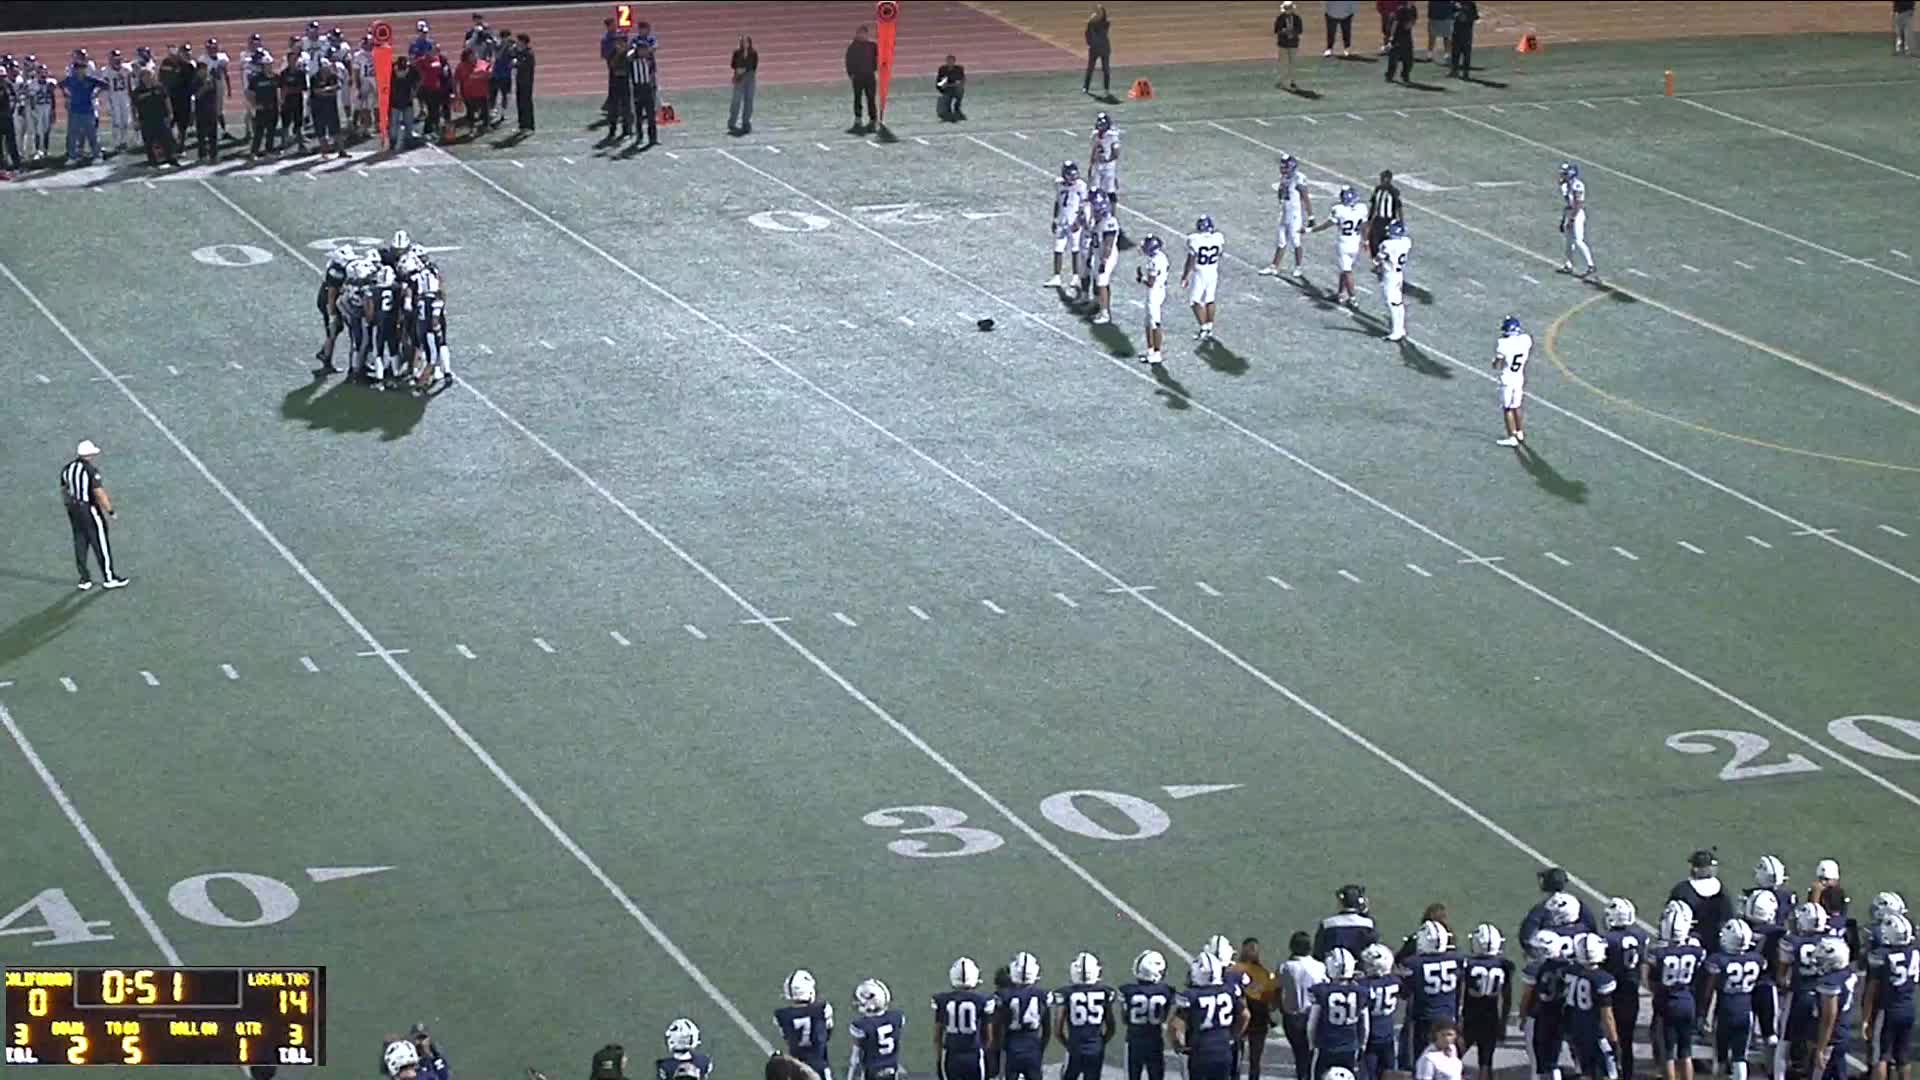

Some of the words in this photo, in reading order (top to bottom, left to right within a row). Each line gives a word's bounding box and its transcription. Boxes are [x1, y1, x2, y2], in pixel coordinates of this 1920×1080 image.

[619, 5, 631, 27] 2
[1060, 191, 1070, 208] 7
[1342, 219, 1363, 236] 24
[1198, 246, 1219, 265] 62
[382, 289, 393, 311] 2
[1510, 354, 1523, 373] 5
[1423, 960, 1457, 995] 55
[1469, 966, 1504, 997] 30
[1724, 961, 1760, 993] 22
[946, 1000, 977, 1034] 10
[1009, 996, 1040, 1030] 14
[1070, 991, 1105, 1026] 65
[1130, 993, 1166, 1025] 20
[1197, 992, 1233, 1030] 72
[1328, 992, 1359, 1025] 61
[793, 1016, 812, 1046] 7
[877, 1023, 895, 1055] 5
